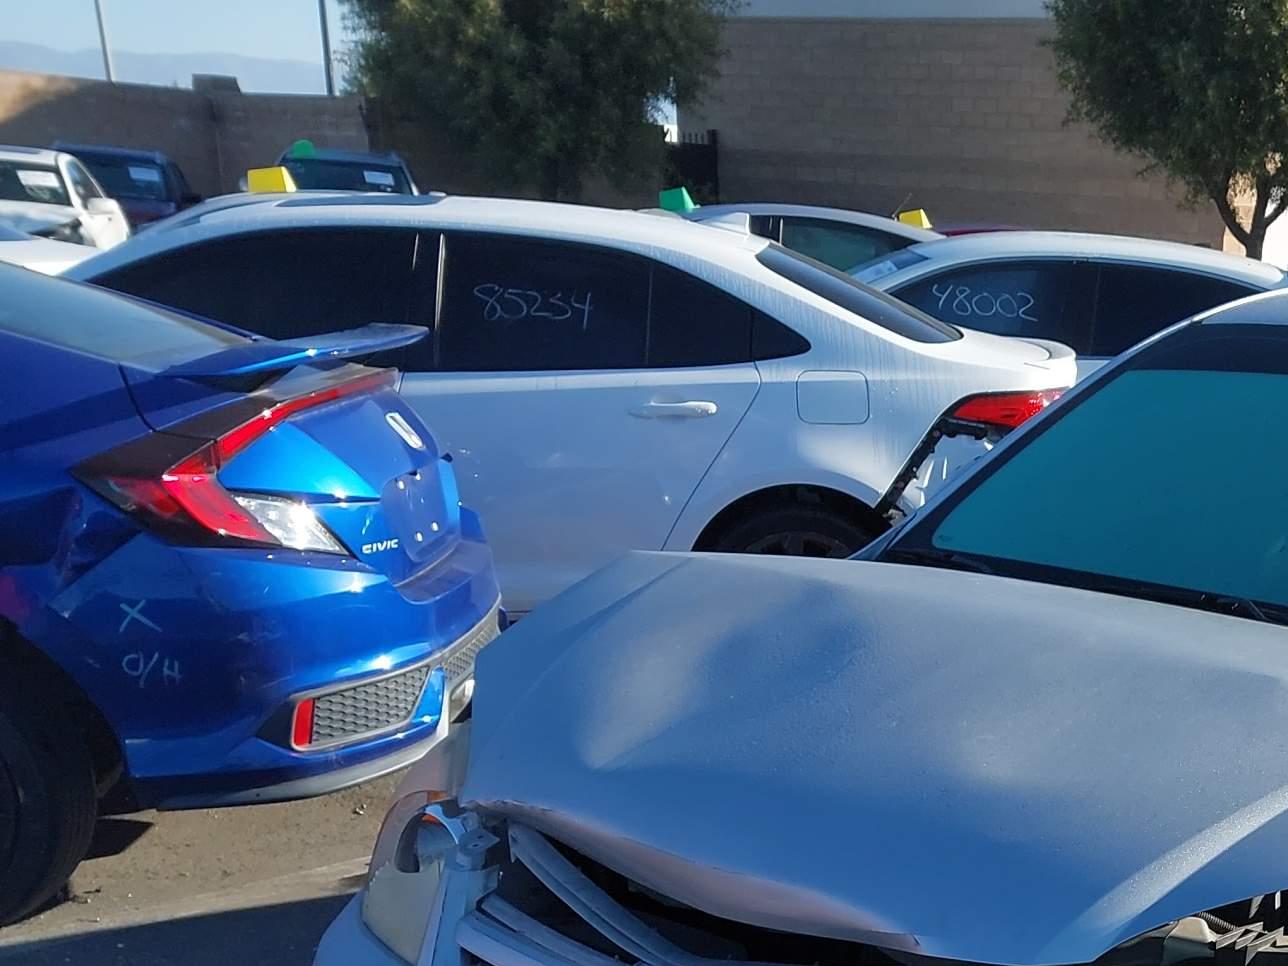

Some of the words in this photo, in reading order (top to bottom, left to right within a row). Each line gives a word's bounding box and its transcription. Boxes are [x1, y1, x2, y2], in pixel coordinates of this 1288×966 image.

[473, 283, 593, 330] 85254
[932, 283, 1039, 322] 48002
[362, 539, 399, 554] CIVIC
